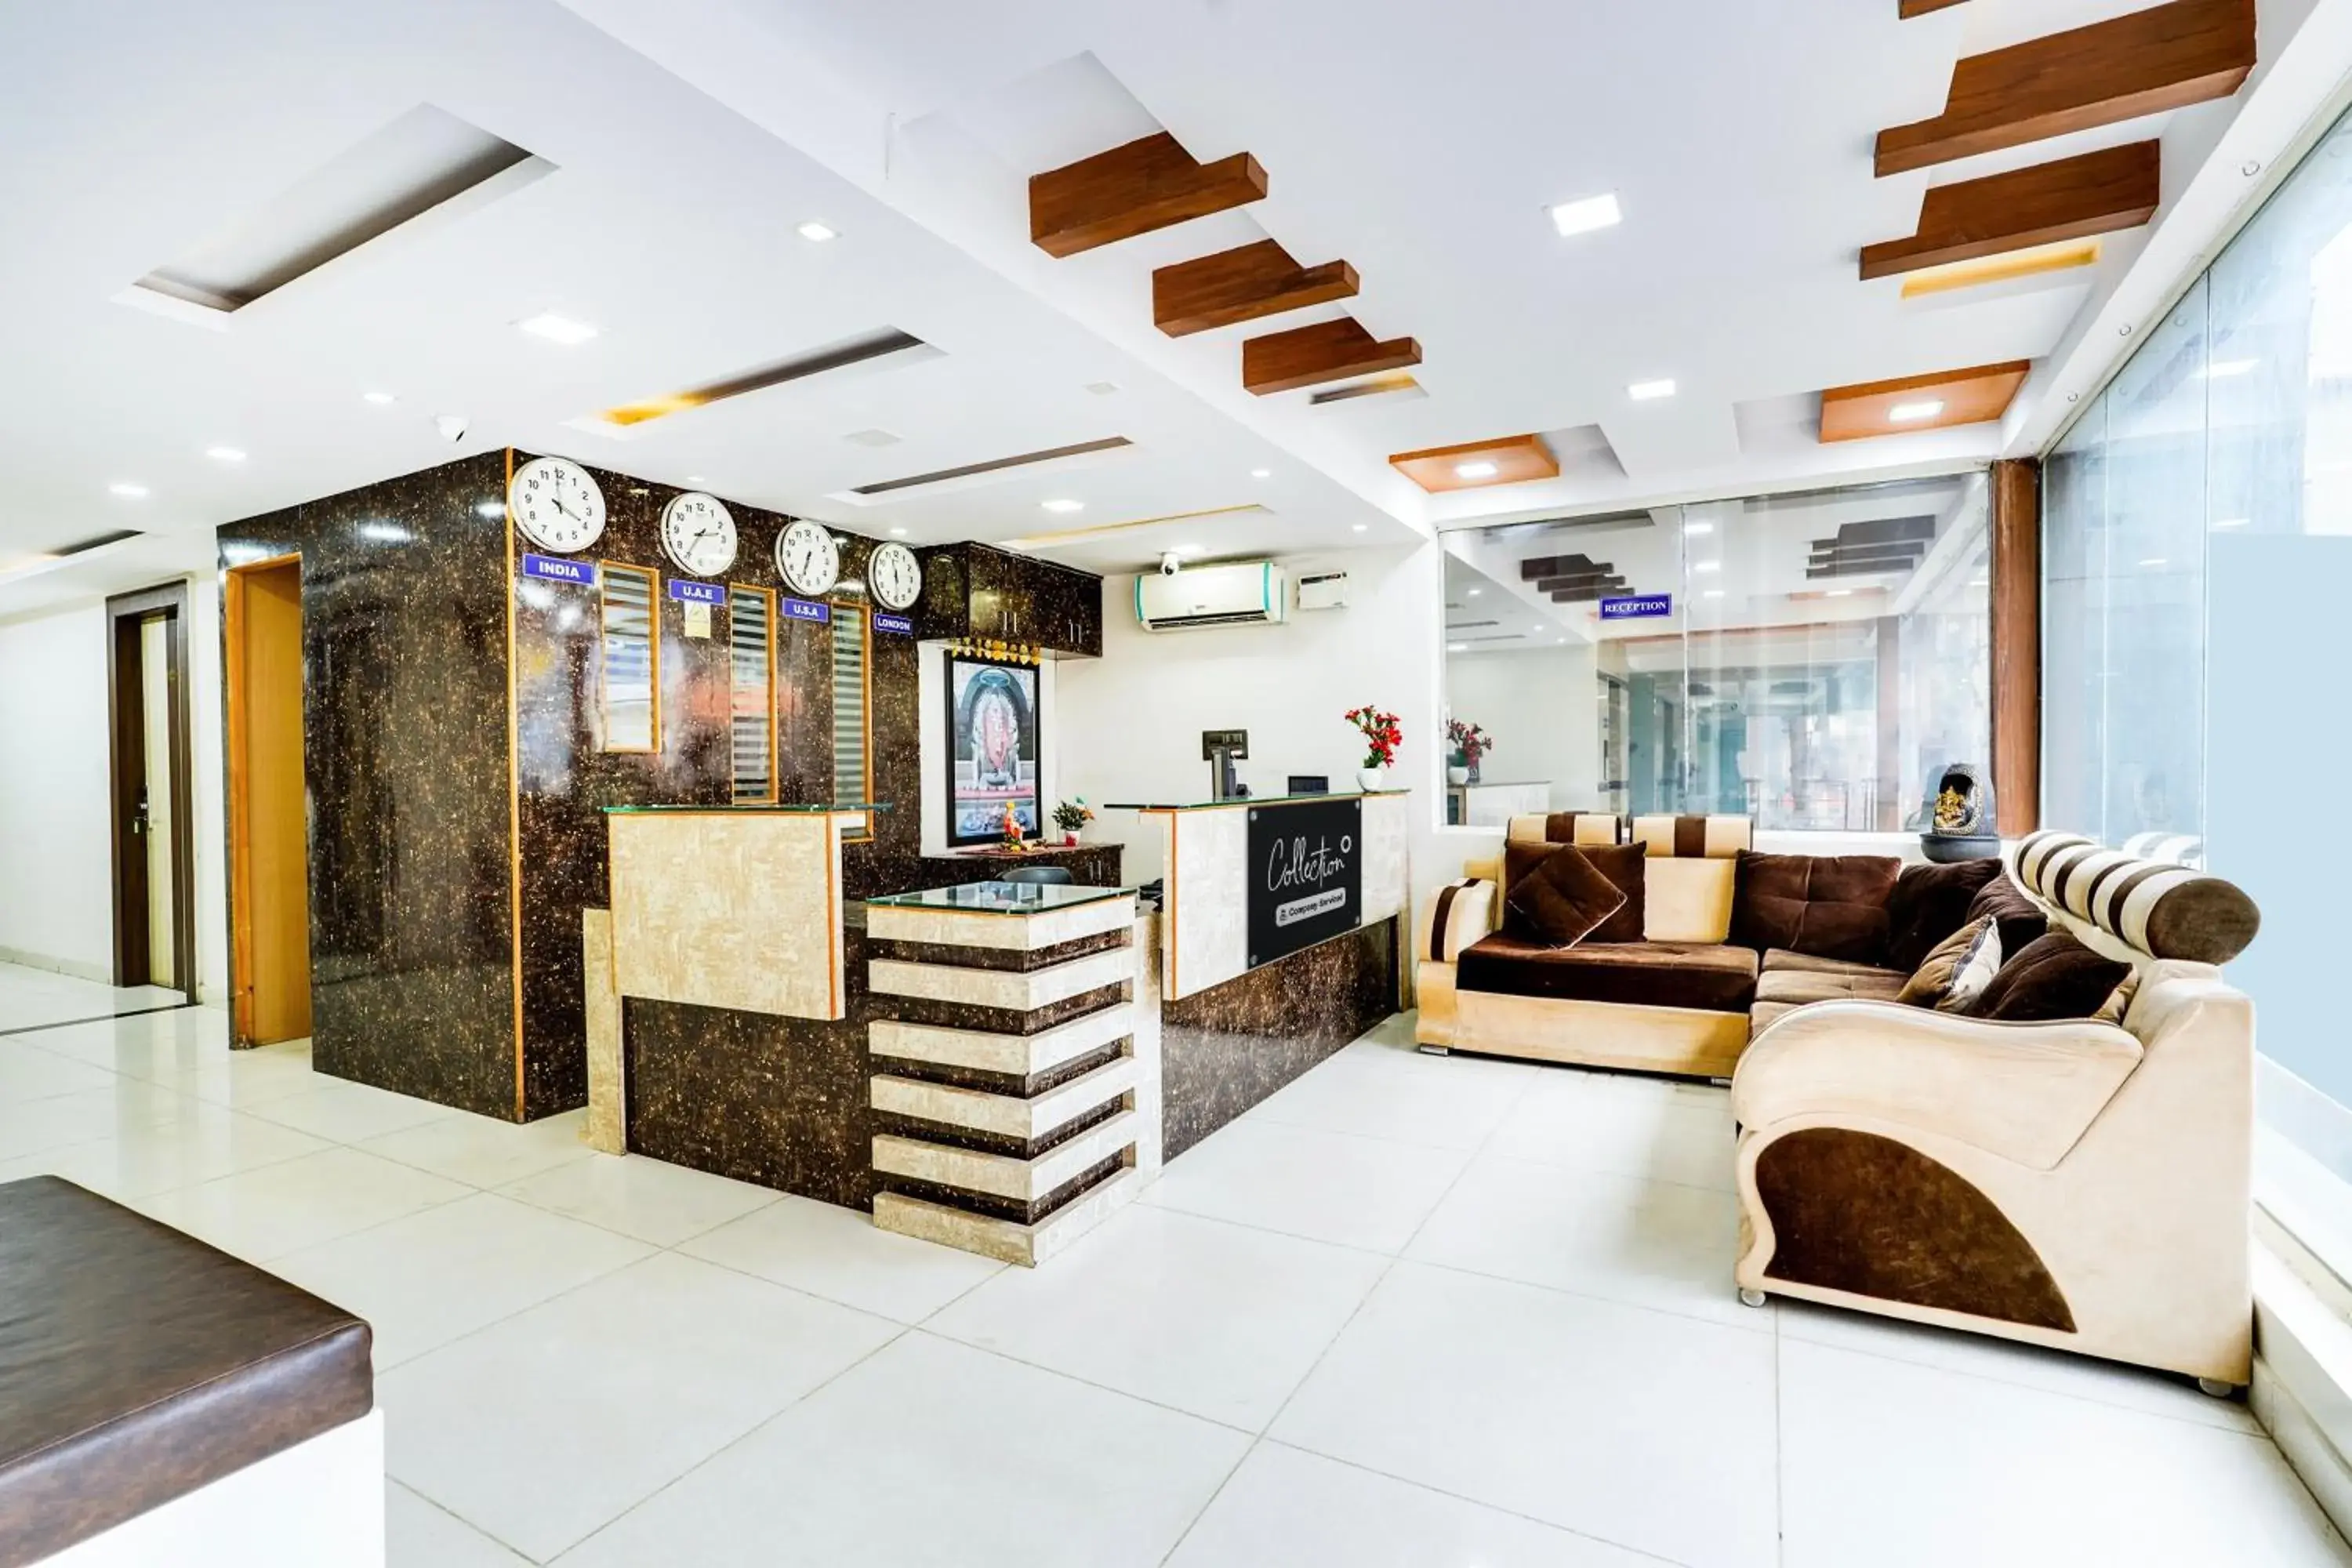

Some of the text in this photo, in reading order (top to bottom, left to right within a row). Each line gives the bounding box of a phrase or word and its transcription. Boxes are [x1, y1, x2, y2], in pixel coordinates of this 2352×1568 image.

[539, 470, 550, 481] 11
[528, 479, 539, 490] 10
[572, 477, 577, 487] 1
[524, 493, 532, 503] 9
[581, 490, 589, 500] 2
[586, 506, 593, 517] 3
[684, 504, 692, 514] 11
[695, 503, 706, 512] 12
[529, 510, 535, 520] 8
[676, 512, 685, 522] 10
[710, 510, 714, 518] 1
[541, 524, 548, 533] 7
[583, 521, 589, 531] 4
[674, 525, 680, 534] 9
[717, 521, 723, 530] 2
[556, 532, 563, 541] 6
[572, 530, 578, 540] 5
[720, 535, 727, 544] 3
[677, 541, 683, 550] 8
[539, 561, 580, 579] INDIA
[683, 585, 713, 600] U.A.E
[793, 604, 818, 617] U.S.A
[1605, 601, 1666, 612] RECEPTION
[877, 618, 910, 631] LONDON
[1268, 835, 1345, 891] Collection
[1288, 902, 1317, 916] Company
